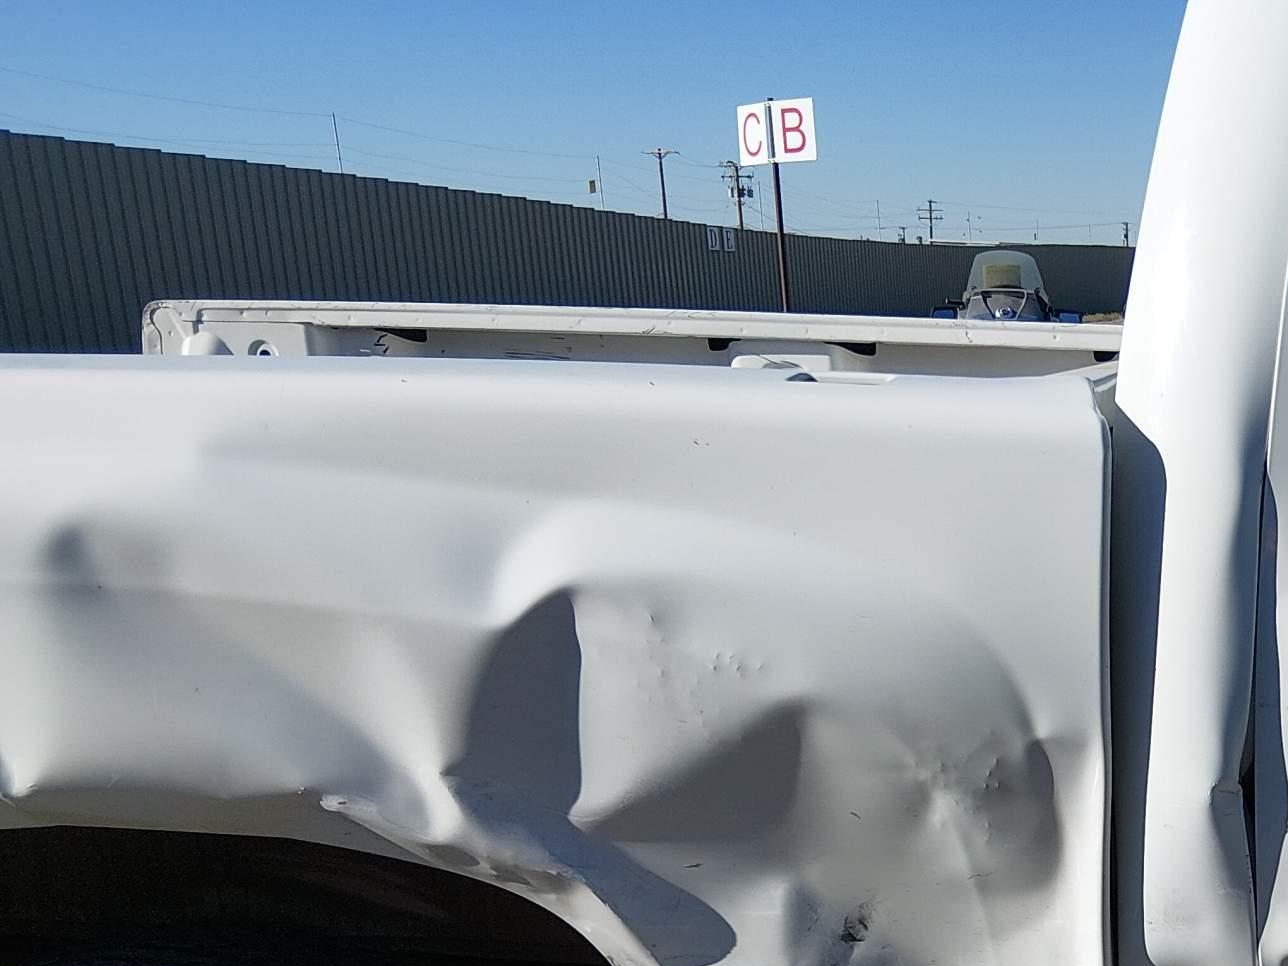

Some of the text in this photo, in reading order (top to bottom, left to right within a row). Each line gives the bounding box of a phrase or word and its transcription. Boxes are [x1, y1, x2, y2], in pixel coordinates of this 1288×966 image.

[743, 112, 762, 157] C
[780, 107, 806, 154] B
[709, 228, 718, 249] D
[725, 230, 734, 250] E
